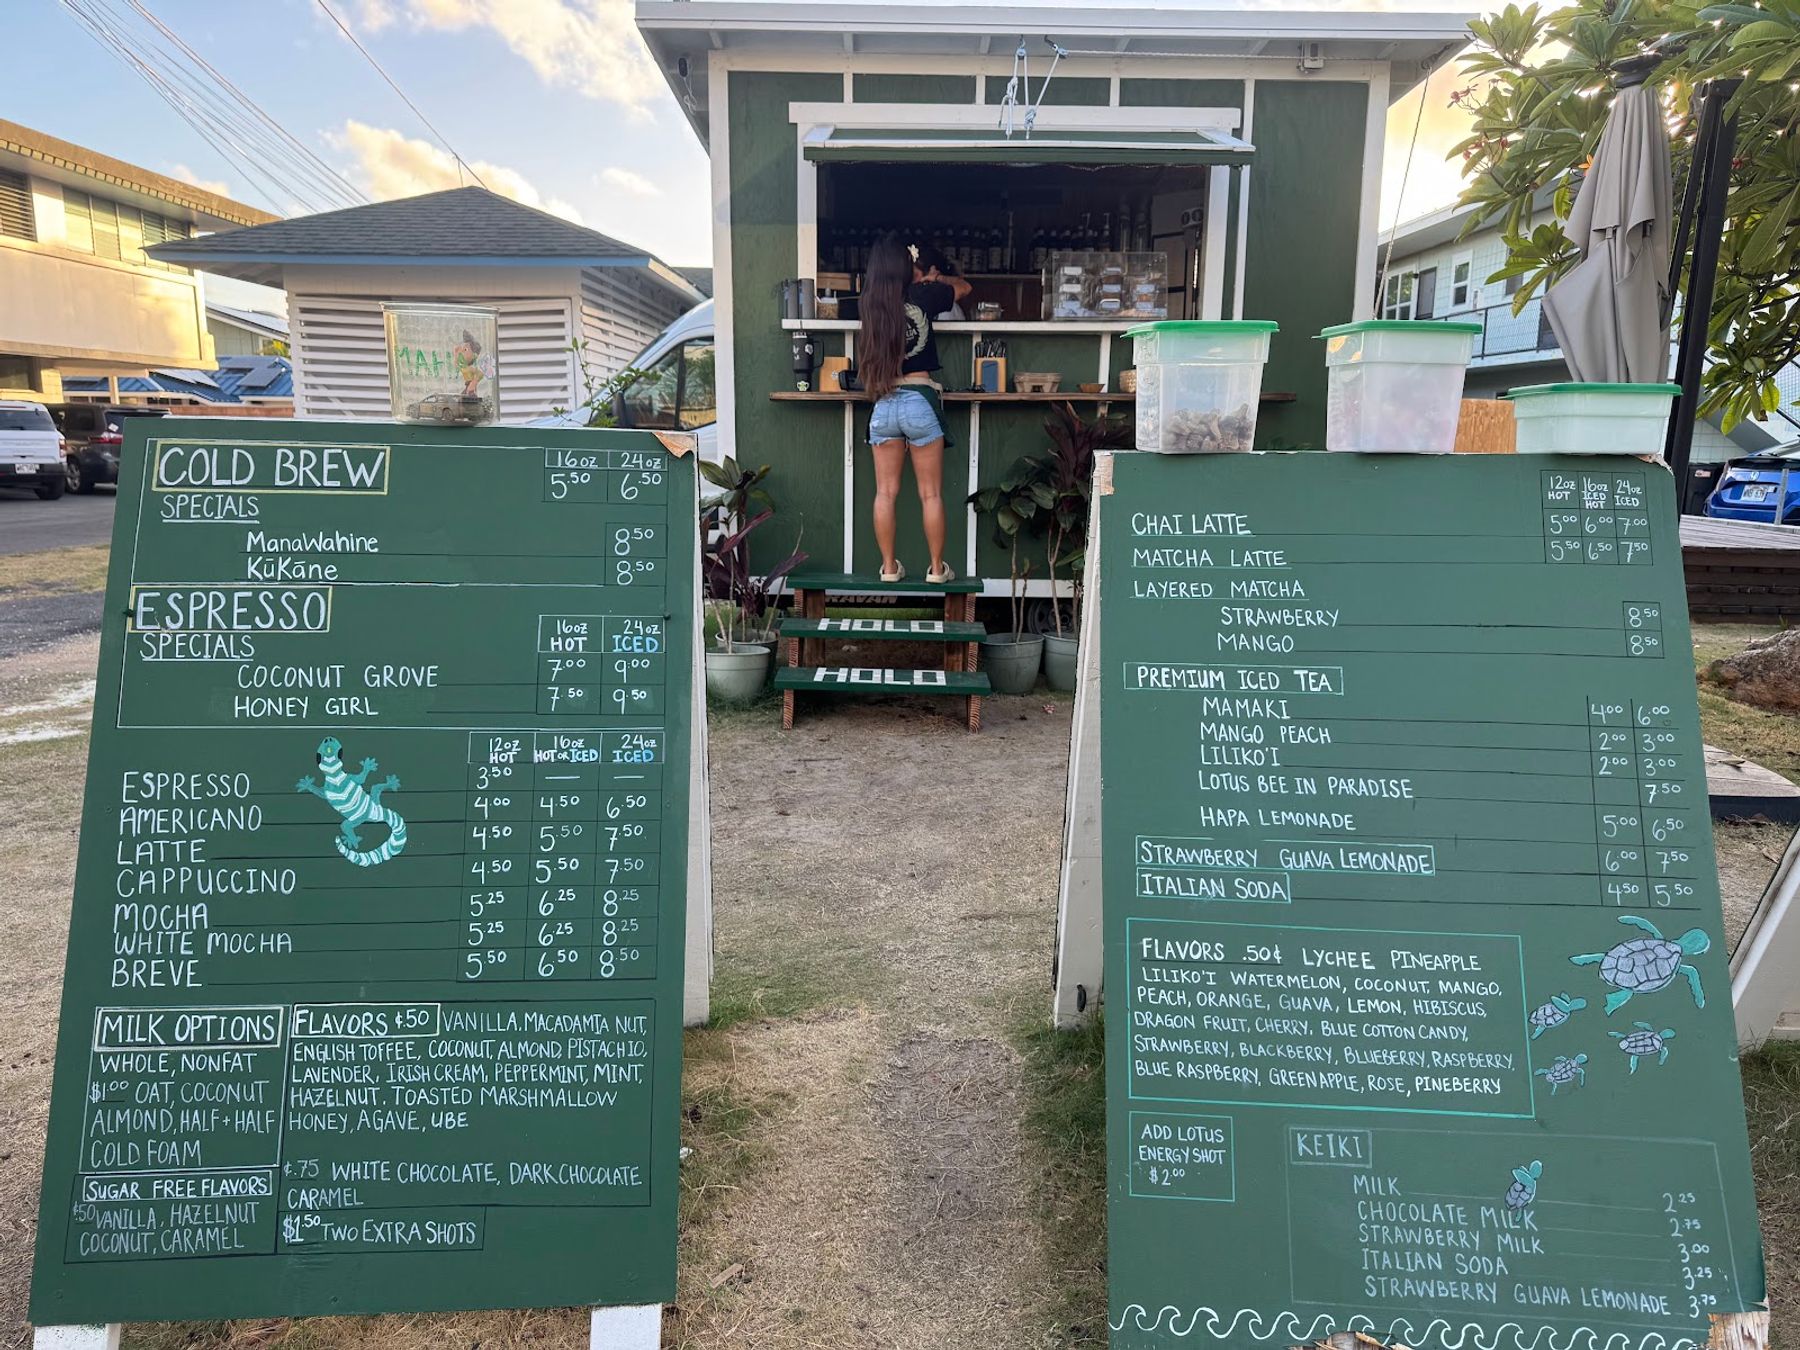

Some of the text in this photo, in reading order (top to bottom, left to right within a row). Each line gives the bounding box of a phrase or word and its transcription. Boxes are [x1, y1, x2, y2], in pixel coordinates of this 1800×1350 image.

[159, 448, 386, 488] COLD BREW
[160, 495, 260, 519] SPECIALS
[1548, 491, 1639, 507] HOT ICED
[1131, 512, 1184, 535] CHAI
[1191, 512, 1252, 534] LATTE
[1132, 548, 1286, 568] MATCHA LATTE
[1133, 579, 1305, 598] LAYERED MATCHA
[136, 591, 328, 631] ESPRESSO
[1221, 606, 1340, 628] STRAWBERRY
[817, 618, 944, 633] HOLO
[140, 634, 255, 659] SPECIALS
[550, 635, 659, 653] HOT ICED
[1216, 632, 1294, 653] MANGO
[238, 665, 343, 688] COCONUT
[364, 665, 438, 688] GROVE
[813, 667, 947, 685] HOLO
[1137, 667, 1333, 692] PREMIUM ICED TEA
[234, 695, 379, 719] HONEY GIRL
[1201, 697, 1292, 719] MAMAKI
[1200, 723, 1264, 744] MANGO
[1279, 725, 1332, 745] PEACH
[489, 752, 517, 763] HOT
[612, 750, 654, 762] ICED
[122, 771, 251, 802] ESPRESSO
[1198, 771, 1250, 793] LOTUS
[1257, 775, 1291, 795] BEE
[1295, 776, 1318, 796] IN
[1328, 776, 1414, 799] PARADISE
[119, 806, 262, 835] AMERICANO
[1200, 808, 1250, 828] HAPA
[1258, 810, 1356, 831] LEMONADE
[117, 839, 206, 865] LATTE
[1141, 841, 1432, 873] STRAWBERRY GUAVA LEMONADE
[116, 868, 296, 897] CAPPUCCINO
[1141, 874, 1288, 900] ITALIAN SODA
[114, 903, 208, 931] MOCHA
[114, 929, 292, 957] WHITE MOCHA
[1142, 938, 1225, 961] FLAVORS
[1302, 948, 1375, 969] LYCHEE
[1390, 950, 1482, 971] PINEAPPLE
[111, 958, 202, 988] BREVE
[101, 1014, 276, 1044] MILK OPTIONS
[295, 1009, 388, 1035] FLAVORS
[524, 1012, 609, 1035] MACADAMIA
[1134, 1011, 1196, 1029] DRAGON
[1321, 1020, 1357, 1037] BLUE
[1363, 1023, 1416, 1040] COTTON
[181, 1052, 257, 1073] NONFAT
[294, 1042, 355, 1063] ENGLISH
[386, 1062, 431, 1083] IRISH
[1135, 1059, 1173, 1077] BLUE
[1415, 1075, 1501, 1094] PINEBERRY
[180, 1081, 270, 1104] COCONUT
[391, 1086, 618, 1107] TOASTED MARSHMALLOW
[180, 1108, 220, 1134] HALF
[235, 1109, 275, 1134] HALF
[431, 1112, 469, 1129] UBE
[1141, 1123, 1224, 1143] ADD LOTUS
[91, 1139, 201, 1168] COLD FOAM
[1139, 1145, 1226, 1165] ENERGY SHOT
[1297, 1132, 1362, 1159] KEIKI
[332, 1160, 390, 1182] WHITE
[509, 1162, 558, 1185] DARK
[559, 1164, 642, 1186] CHOCOLATE
[86, 1176, 268, 1200] SUGAR FREE FLAVORS
[1354, 1175, 1400, 1196] MILK
[287, 1187, 364, 1210] CARAMEL
[170, 1201, 260, 1226] HAZELNUT
[1358, 1201, 1469, 1225] CHOCOLATE
[321, 1223, 358, 1242] TWO
[363, 1219, 422, 1244] EXTRA
[426, 1221, 476, 1245] SHOTS
[1359, 1224, 1480, 1251] STRAWBERRY
[1497, 1232, 1544, 1255] MILK
[1362, 1248, 1508, 1276] ITALIAN SODA
[1365, 1276, 1671, 1316] STRAWBERRY GUAVA LEMONADE
